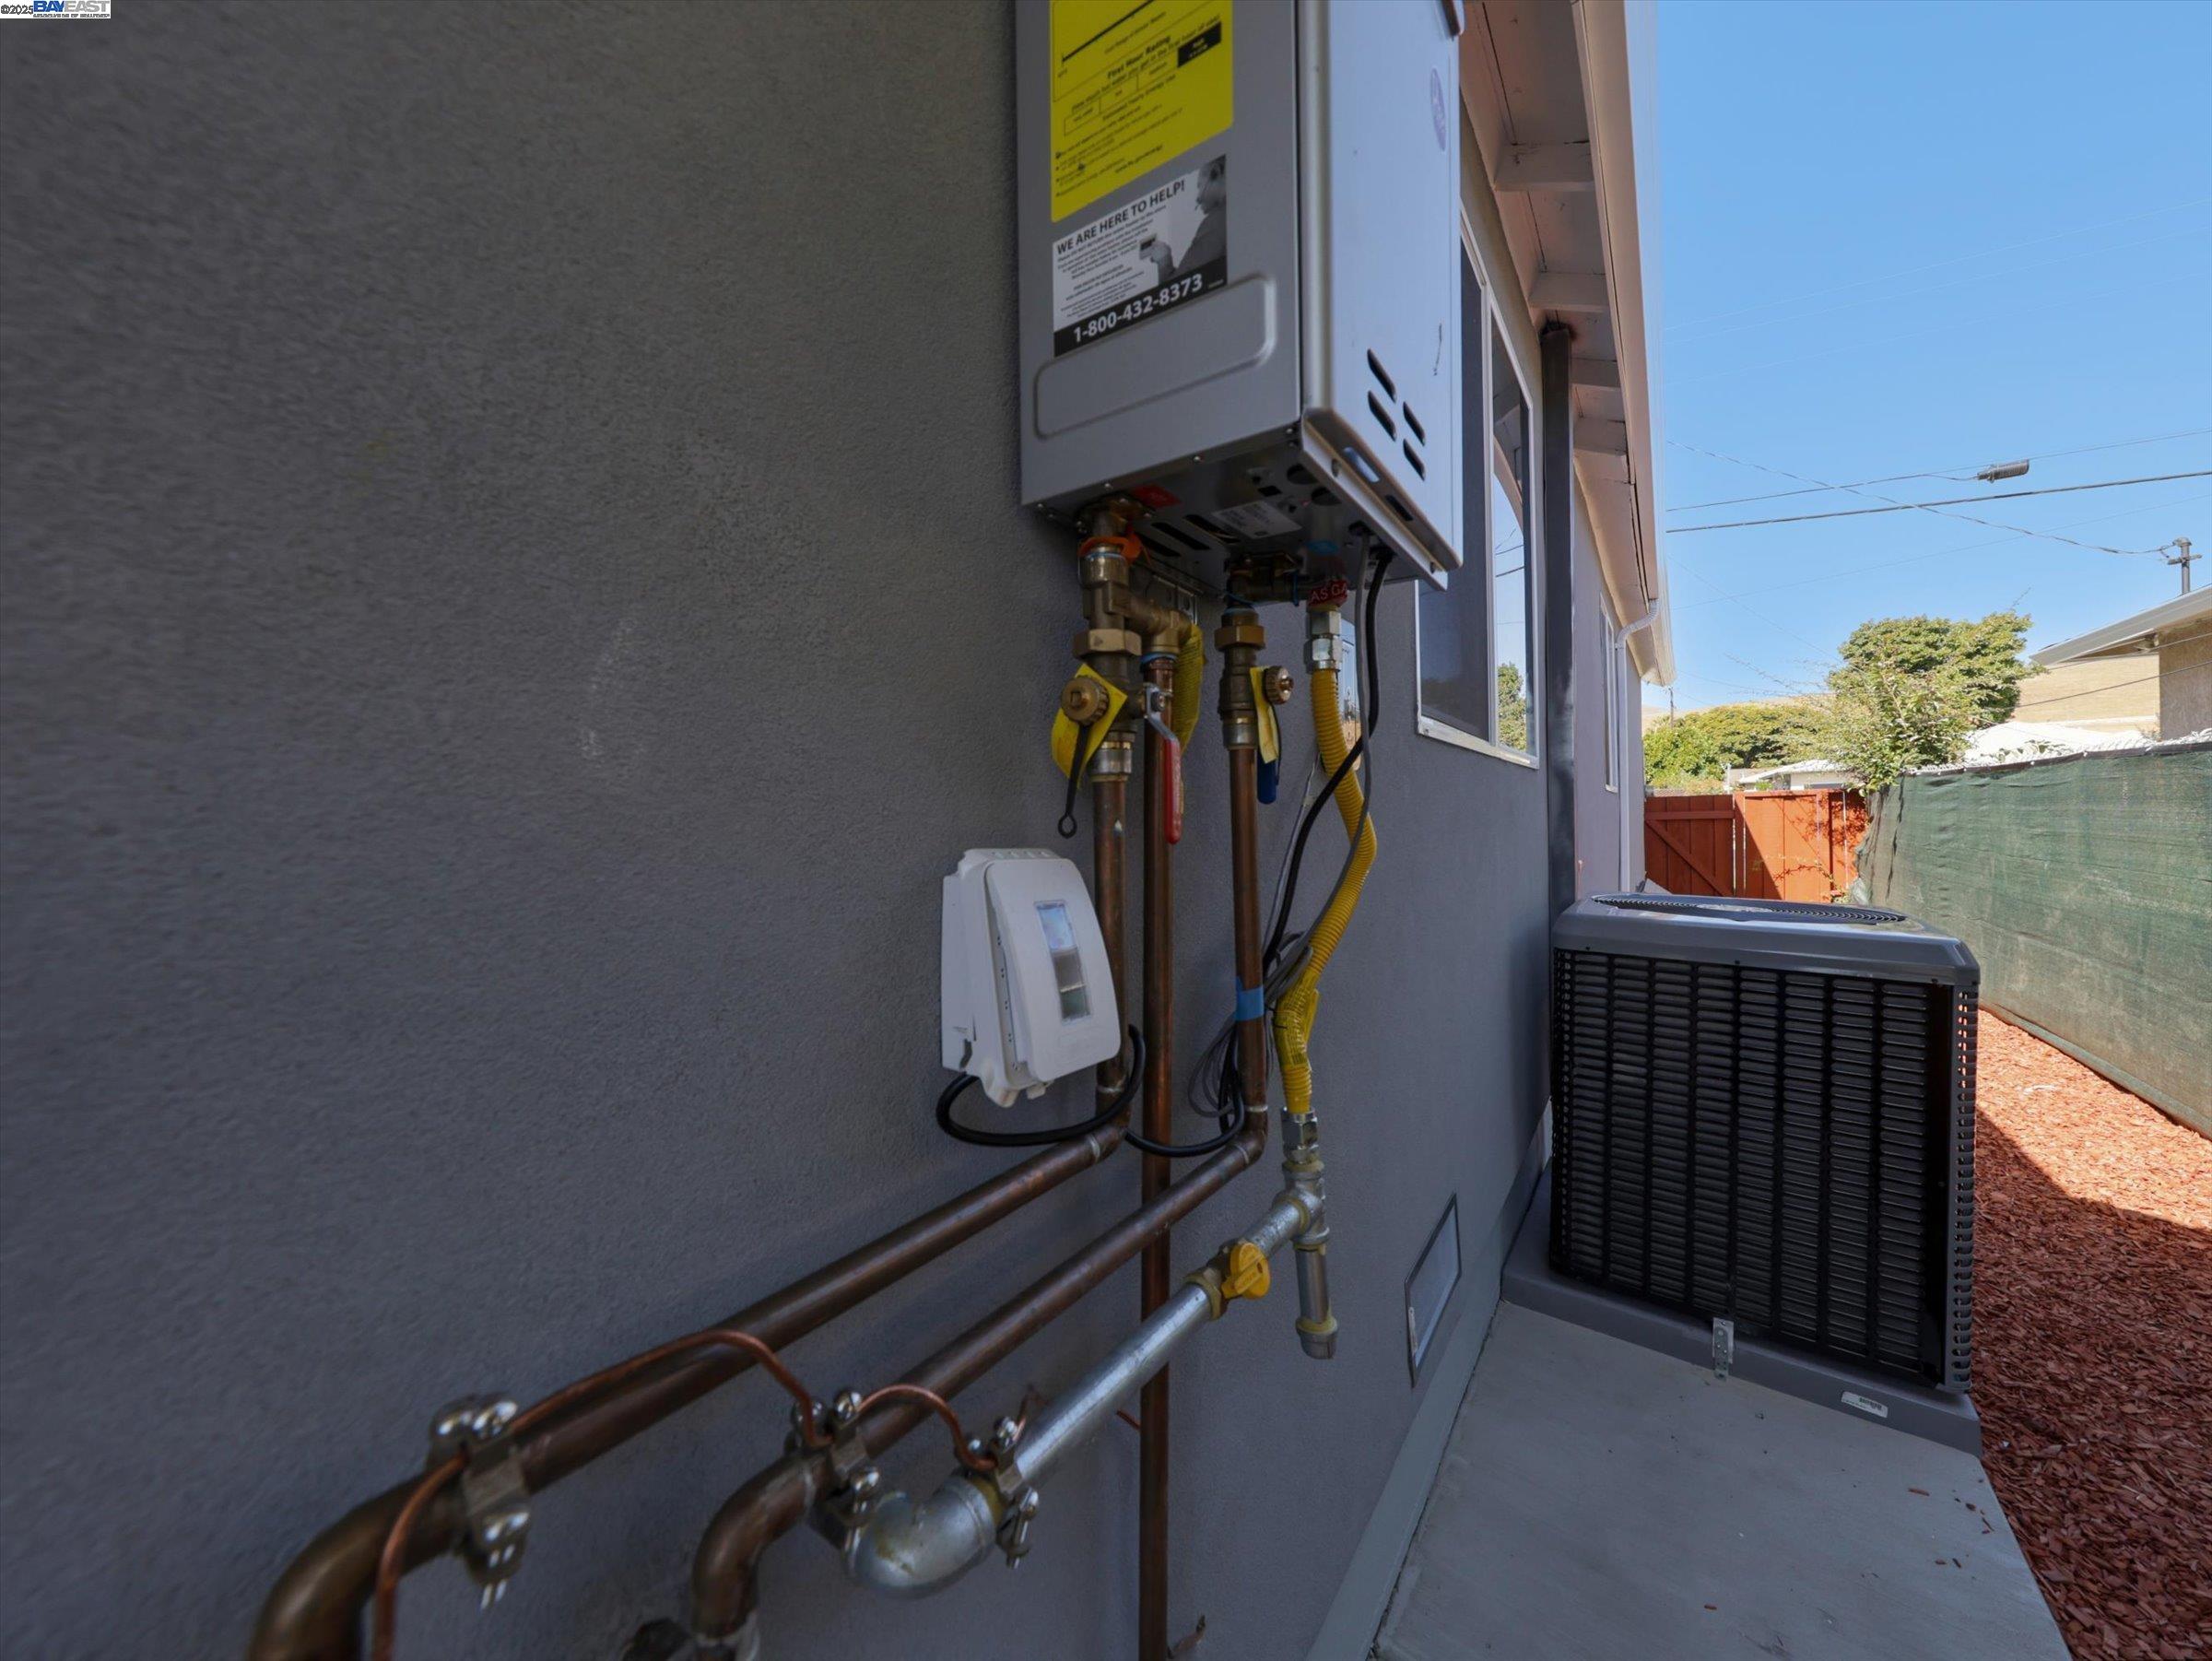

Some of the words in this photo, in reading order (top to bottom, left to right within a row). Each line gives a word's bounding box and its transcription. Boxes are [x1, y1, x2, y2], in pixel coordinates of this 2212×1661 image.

[1057, 240, 1075, 254] WE
[1076, 225, 1097, 245] ARE
[1100, 209, 1129, 232] HERE
[1131, 200, 1147, 217] TO
[1149, 180, 1185, 207] HELP!
[1074, 273, 1203, 343] 1-800-432-8373
